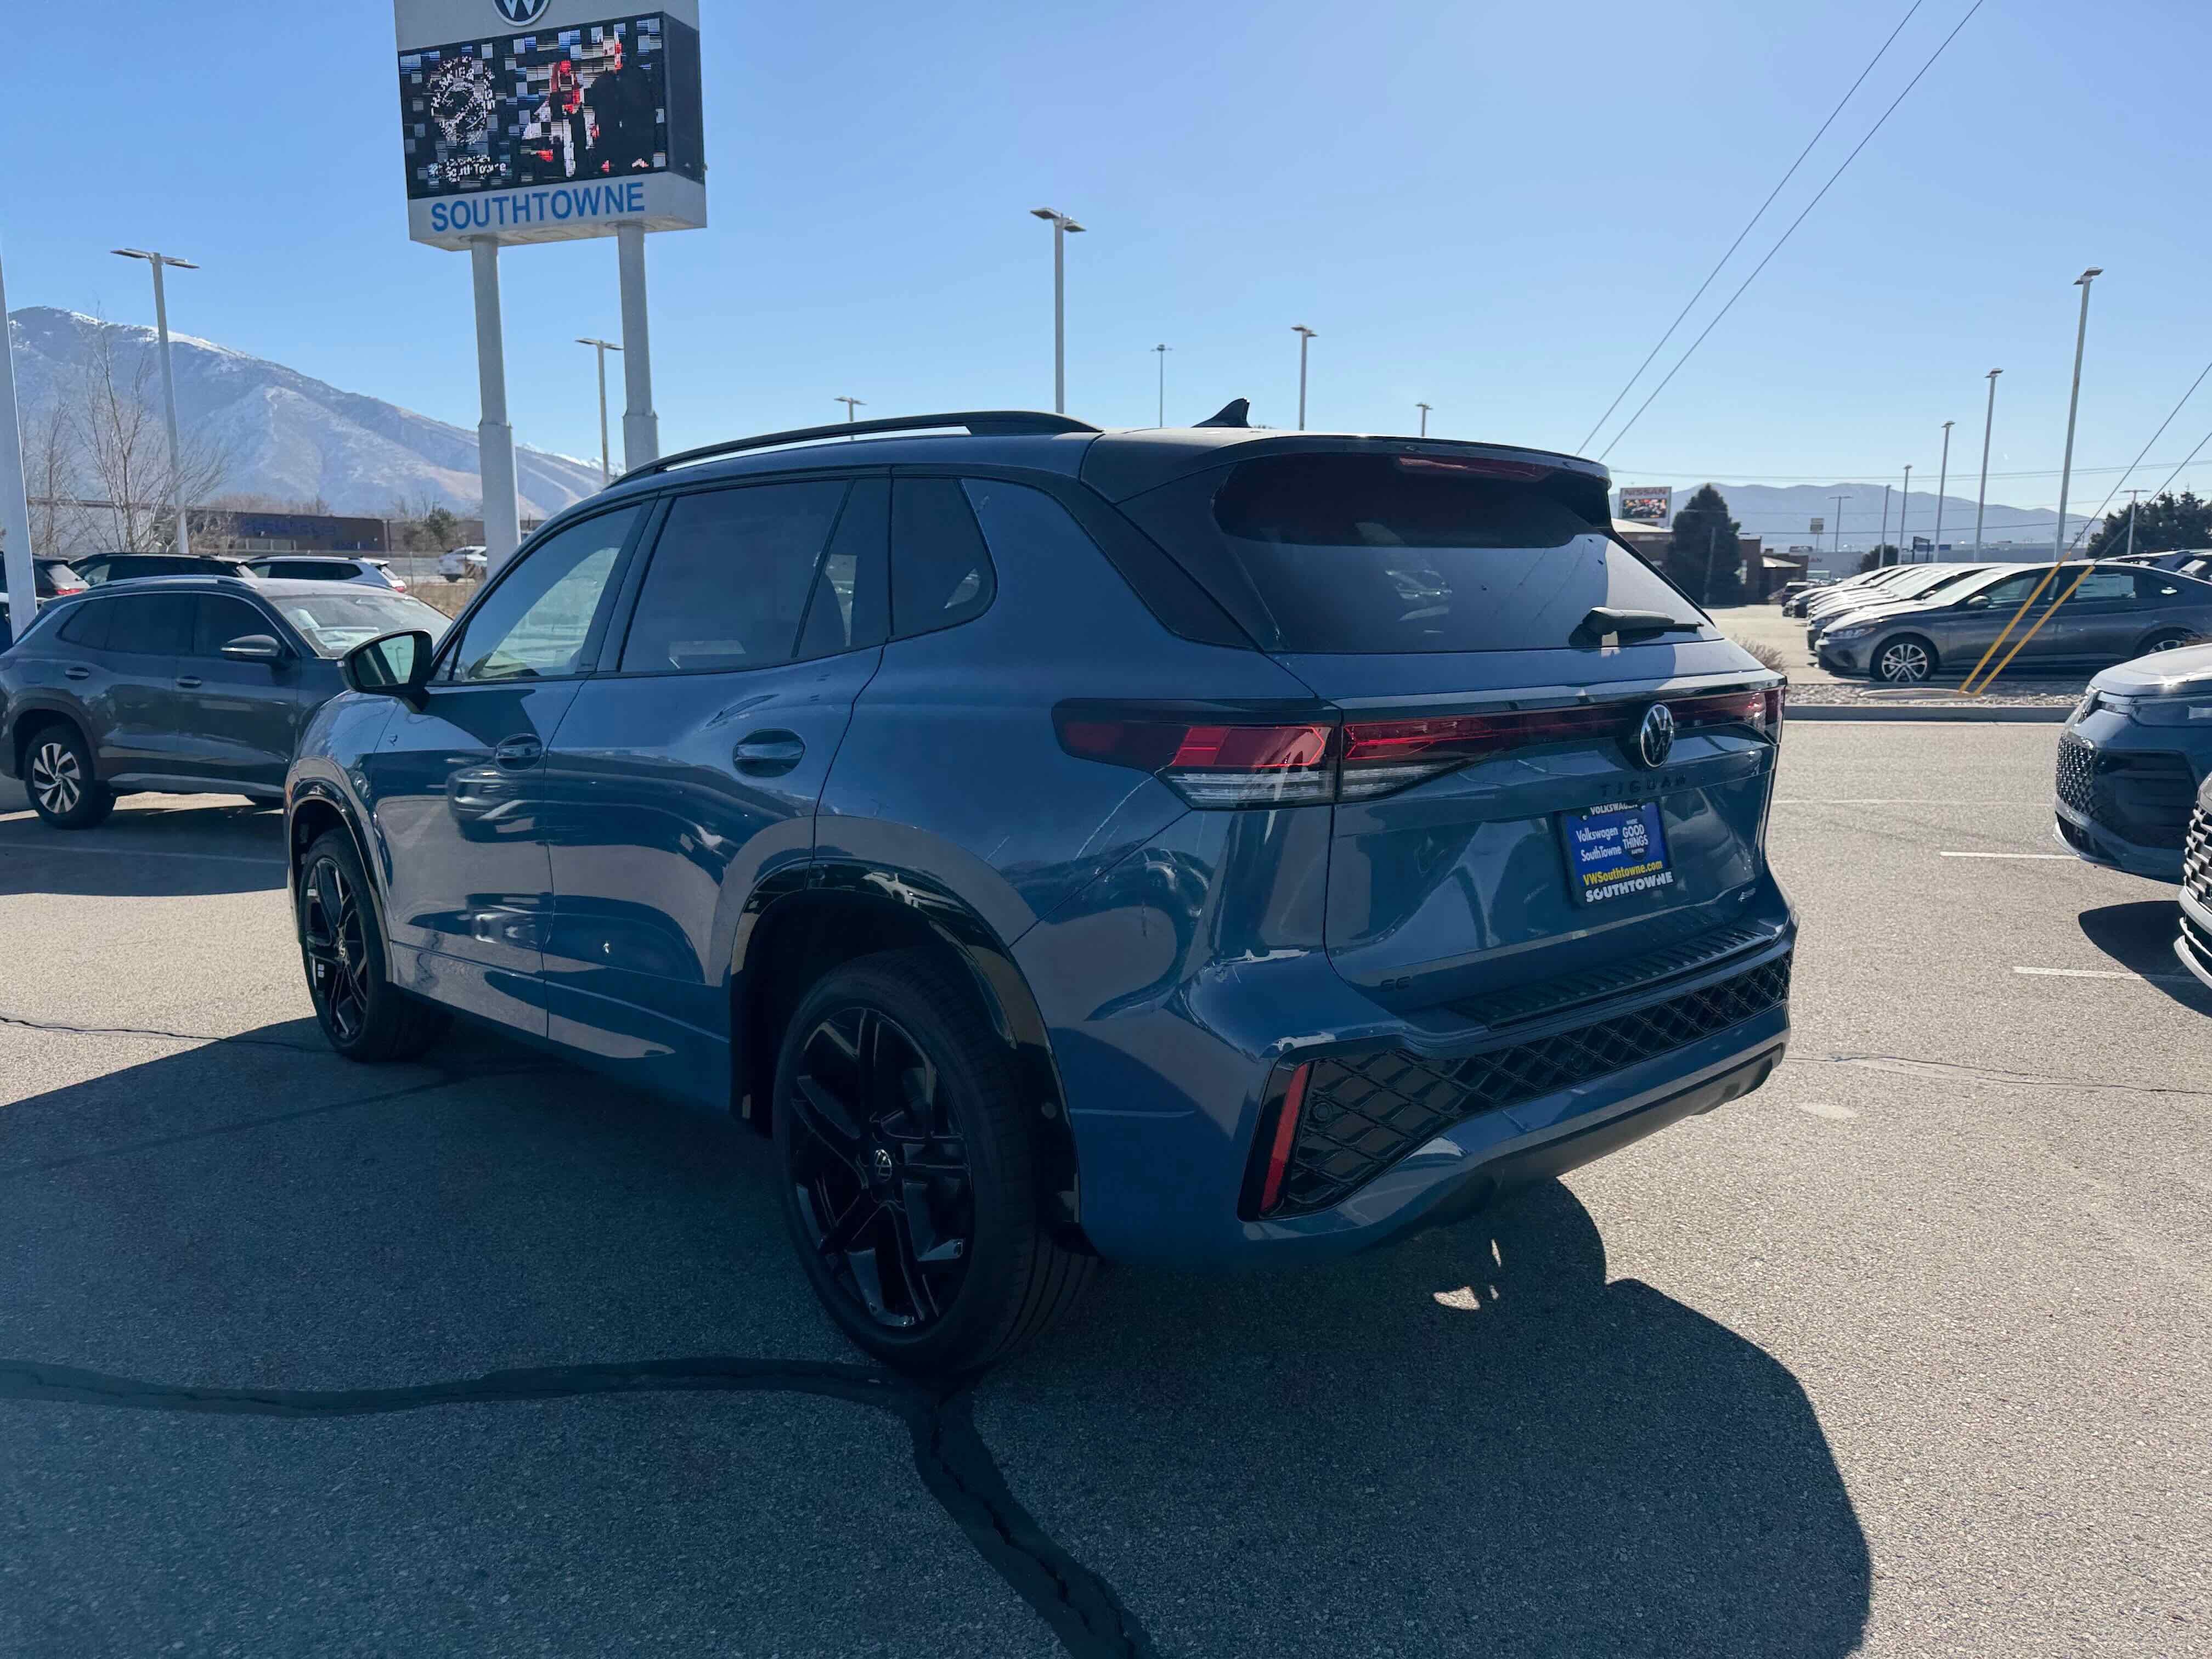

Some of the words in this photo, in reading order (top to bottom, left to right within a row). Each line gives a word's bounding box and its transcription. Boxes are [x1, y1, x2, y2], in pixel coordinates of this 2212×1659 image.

[431, 182, 645, 232] SOUTHTOWNE
[1600, 775, 1686, 796] TIGUAN
[1590, 803, 1638, 815] VOLKSWAG
[1576, 827, 1618, 843] Volkswagen
[1622, 824, 1645, 838] GOOD
[1622, 834, 1649, 850] THINGS
[1581, 845, 1622, 862] SouthTowne
[1582, 860, 1663, 886] VWSouthtowne.com
[1585, 871, 1674, 902] SOUTHTOWNE
